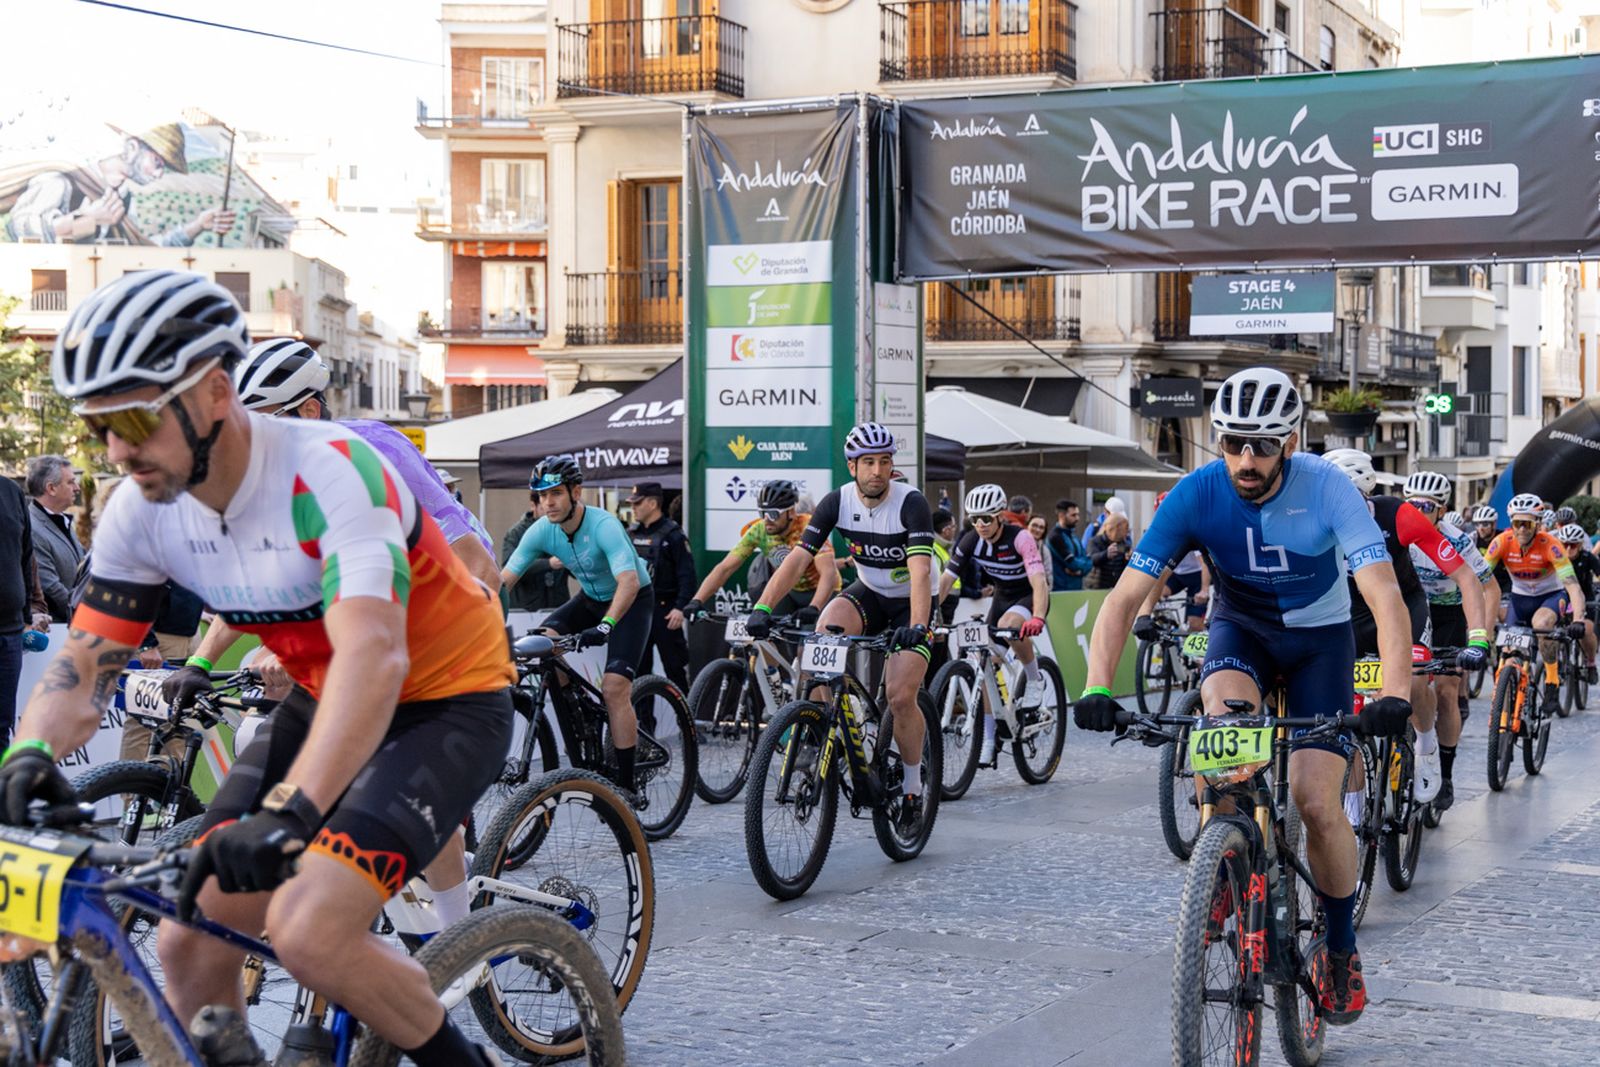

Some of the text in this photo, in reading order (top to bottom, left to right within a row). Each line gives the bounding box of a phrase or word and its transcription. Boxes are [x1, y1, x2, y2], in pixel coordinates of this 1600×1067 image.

[929, 116, 1006, 140] Andalucía
[1446, 128, 1483, 147] SHC
[1077, 105, 1356, 183] Andalucía
[1385, 130, 1434, 151] UCI
[717, 157, 827, 193] Andalucía
[950, 163, 1027, 186] GRANADA
[966, 186, 1010, 211] JAÉN
[1388, 181, 1502, 203] GARMIN
[1081, 173, 1358, 232] BIKE RACE
[950, 213, 1027, 237] CÓRDOBA
[760, 265, 809, 277] de Granada
[761, 257, 807, 268] Diputación
[1228, 279, 1296, 295] STAGE 4
[1240, 295, 1283, 312] JAÉN
[1235, 319, 1287, 330] GARMIN
[759, 338, 805, 349] Diputación
[877, 346, 914, 362] GARMIN
[719, 388, 817, 406] GARMIN
[964, 627, 982, 644] 821
[812, 646, 837, 667] 884
[1354, 663, 1380, 683] 337
[1196, 729, 1262, 761] 403-1
